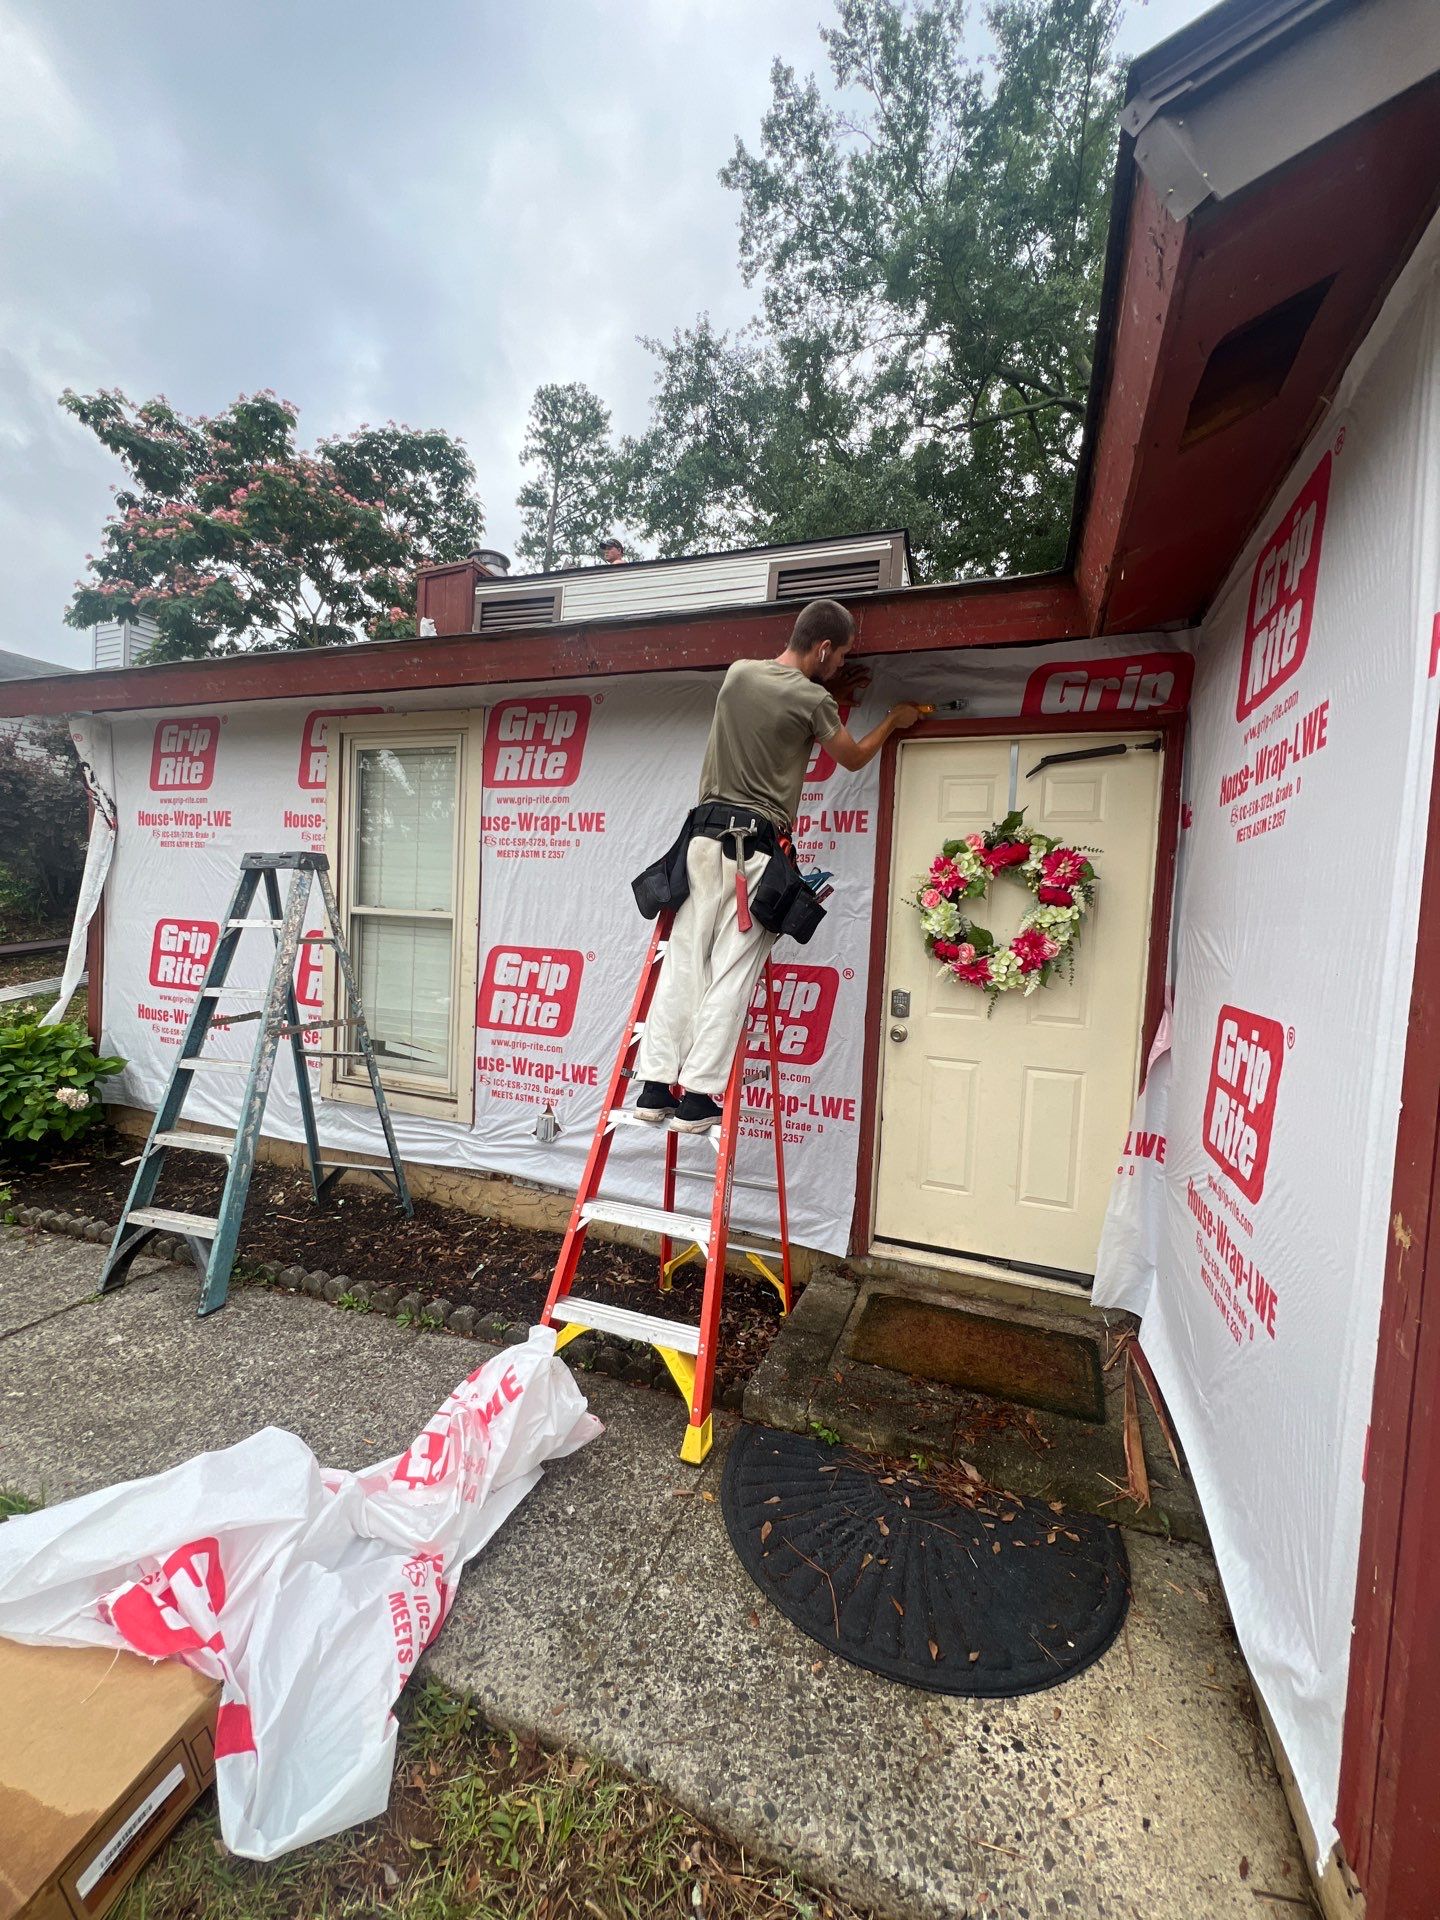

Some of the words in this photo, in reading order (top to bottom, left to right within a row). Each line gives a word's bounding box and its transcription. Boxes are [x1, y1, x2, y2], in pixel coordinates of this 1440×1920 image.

[1253, 500, 1317, 629] Grip
[1244, 598, 1303, 706] Rite
[1040, 665, 1175, 715] Grip
[160, 723, 211, 757] Grip
[497, 704, 578, 746] Grip
[493, 745, 568, 781] Rite
[1219, 698, 1330, 807] House-Wrap-LWE
[157, 756, 205, 786] Rite
[496, 795, 570, 806] www.grip-rite.com
[138, 810, 232, 830] House-Wrap-LWE
[497, 849, 519, 859] MEETS
[521, 849, 540, 859] ASTM
[542, 849, 546, 859] E
[547, 850, 565, 860] 2357
[550, 838, 571, 847] Grade
[575, 838, 581, 847] D
[797, 840, 823, 851] Grade
[830, 840, 836, 850] D
[160, 924, 211, 959] Grip
[157, 955, 205, 986] Rite
[493, 952, 571, 997] Grip
[489, 990, 562, 1029] Rite
[749, 972, 821, 1019] rip
[491, 1038, 563, 1054] www.grip-rite.com
[1217, 1018, 1271, 1114] Grip
[491, 1089, 514, 1100] MEETS
[515, 1093, 534, 1103] ASTM
[535, 1096, 540, 1104] E
[543, 1085, 565, 1096] Grade
[568, 1089, 574, 1097] D
[747, 1129, 773, 1140] ASTM
[782, 1133, 805, 1144] 2357
[785, 1120, 812, 1132] Grade
[817, 1123, 824, 1134] D
[1208, 1086, 1258, 1181] Rite
[388, 1591, 414, 1665] MEETS
